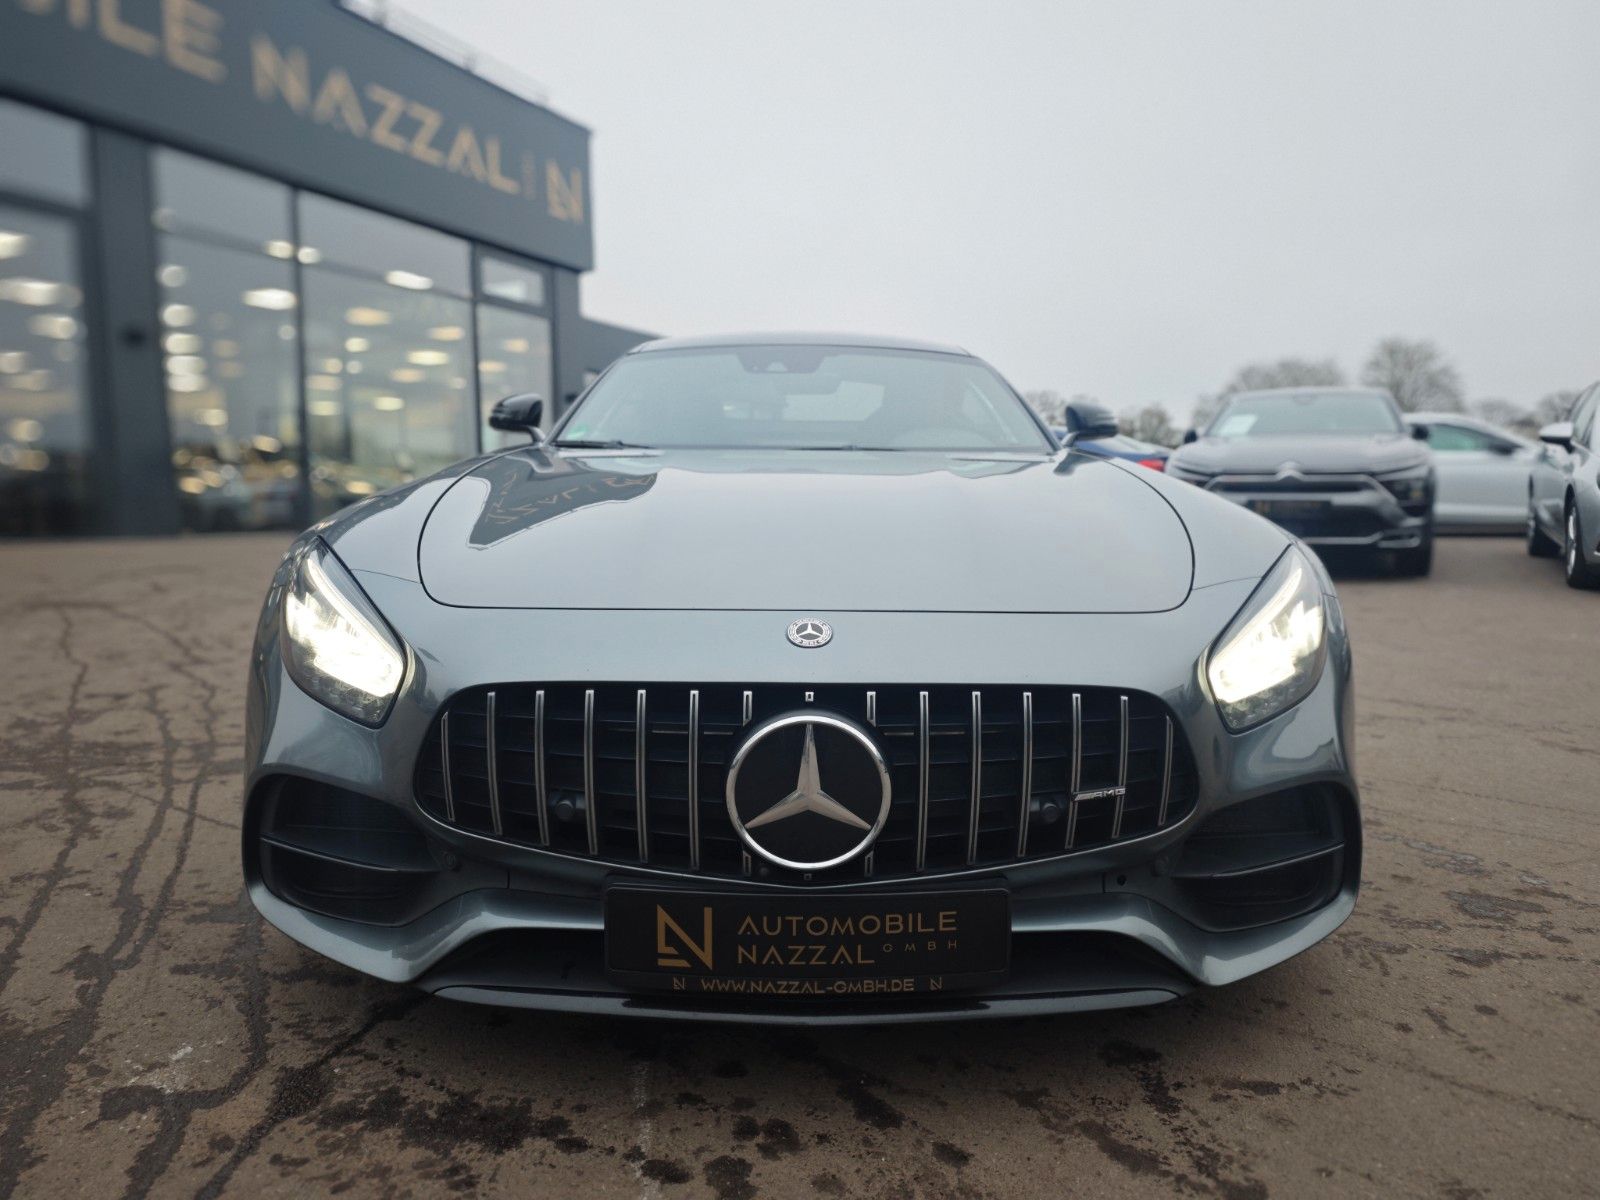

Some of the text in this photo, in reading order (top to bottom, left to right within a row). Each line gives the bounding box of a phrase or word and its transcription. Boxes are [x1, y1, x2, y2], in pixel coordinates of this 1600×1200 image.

[18, 0, 520, 195] LE NAZZAL
[737, 911, 958, 937] AUTOMOBILE
[737, 940, 957, 965] NAZZAL GMBH
[700, 977, 915, 994] WWW.NAZZAL-GMBH.DE
